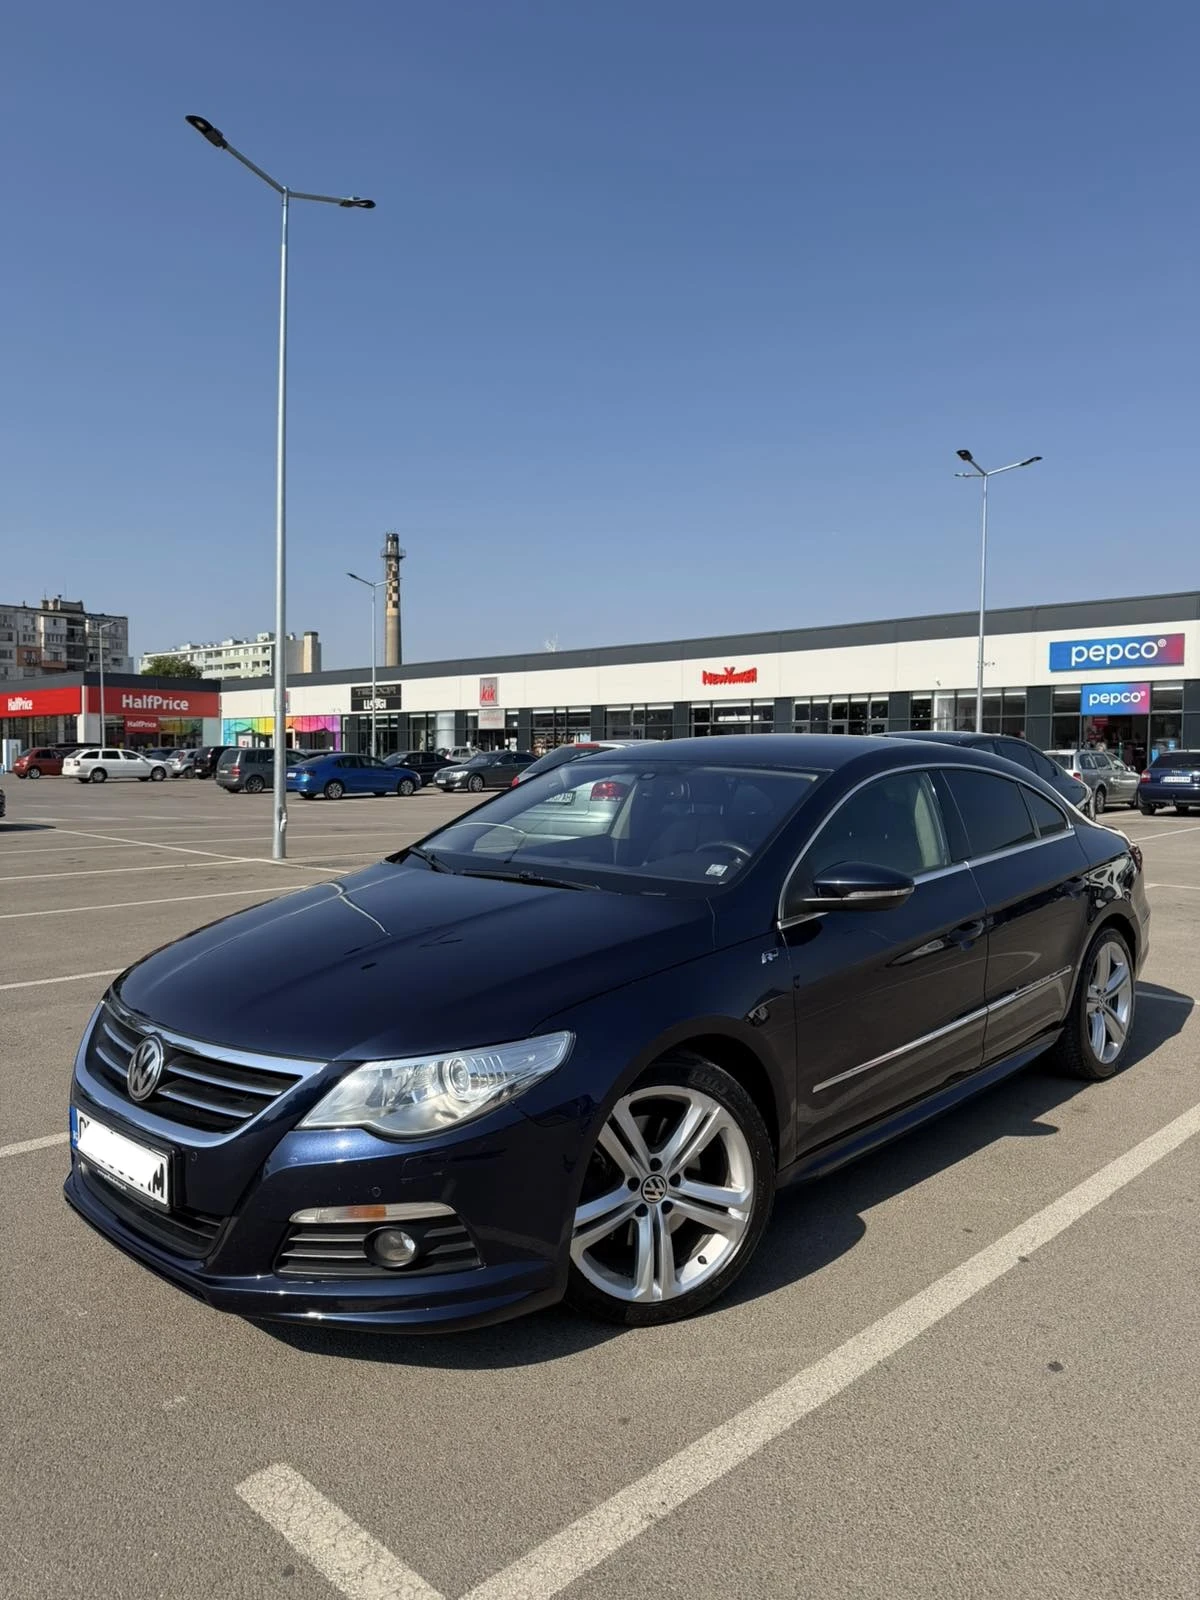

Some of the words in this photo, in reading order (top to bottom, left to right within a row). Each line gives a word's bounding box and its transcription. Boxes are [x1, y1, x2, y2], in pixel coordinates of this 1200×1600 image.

[7, 697, 33, 711] HalfPrice
[121, 695, 189, 711] HalfPrice
[127, 720, 157, 728] HalfPrice
